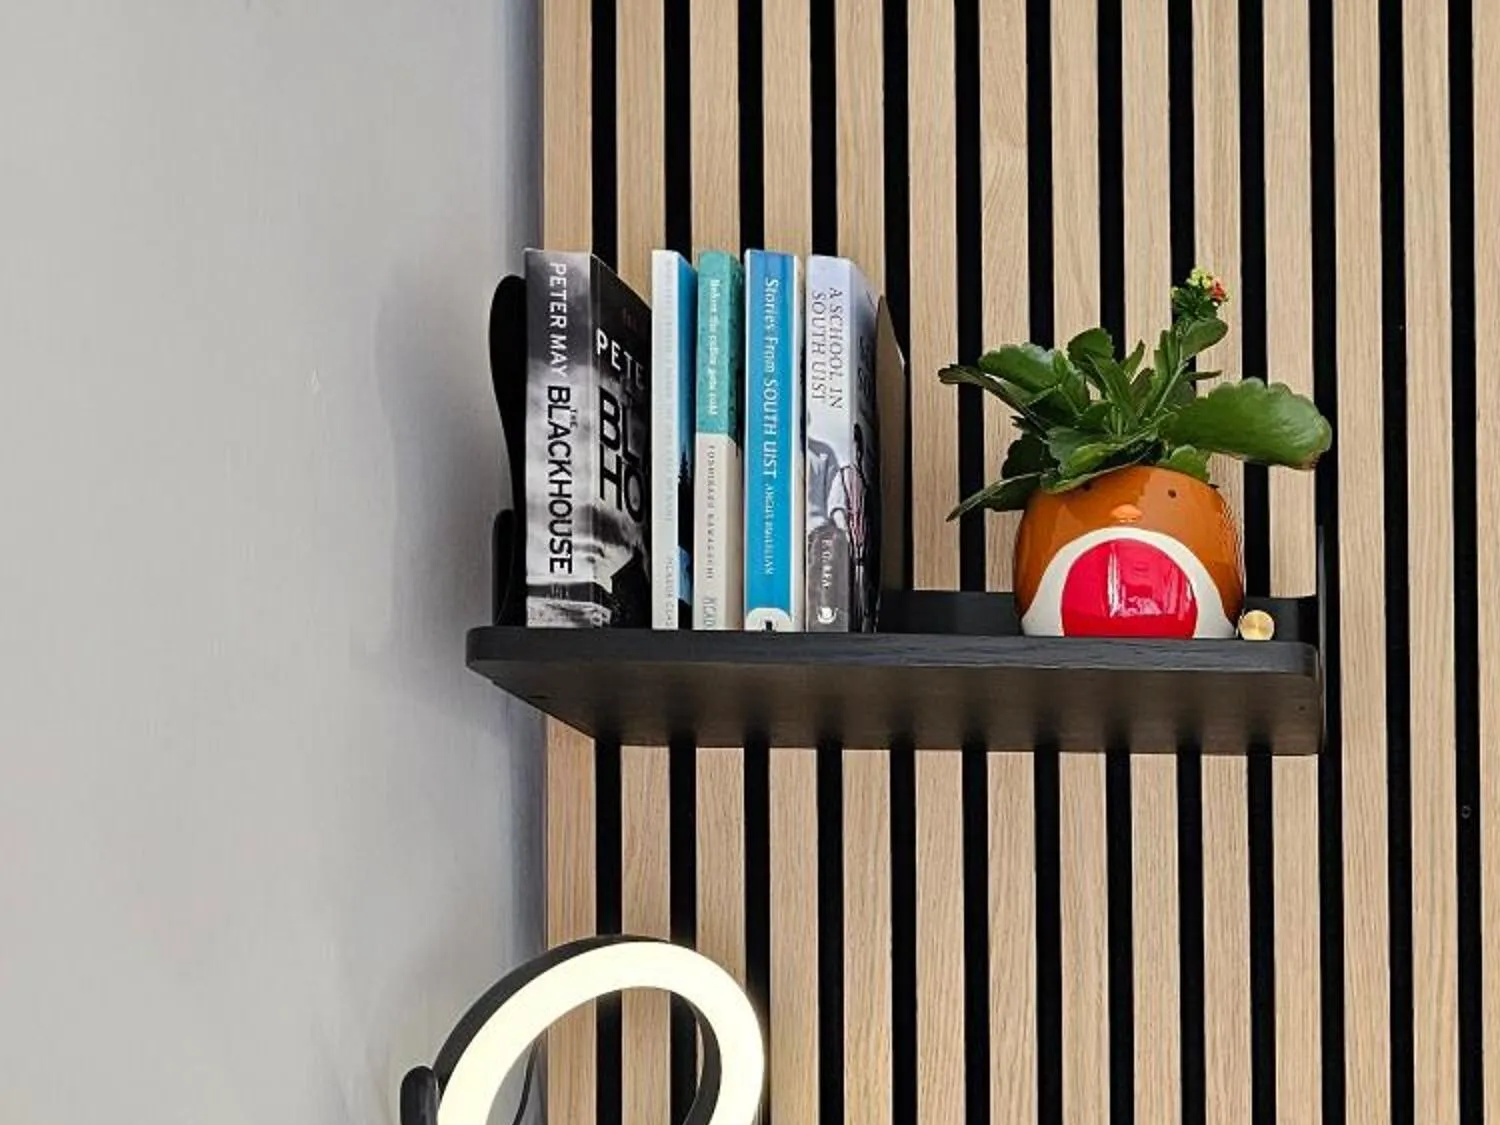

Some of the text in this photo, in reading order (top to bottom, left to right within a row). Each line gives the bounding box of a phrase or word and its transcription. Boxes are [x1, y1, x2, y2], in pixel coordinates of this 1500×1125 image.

[549, 262, 569, 377] PETER MAY
[763, 277, 779, 479] Stories From SOUTH UIST
[811, 291, 827, 404] SOUTH UIST
[829, 287, 844, 410] A SCHOOL IN
[547, 386, 573, 575] BLACKHOUSE
